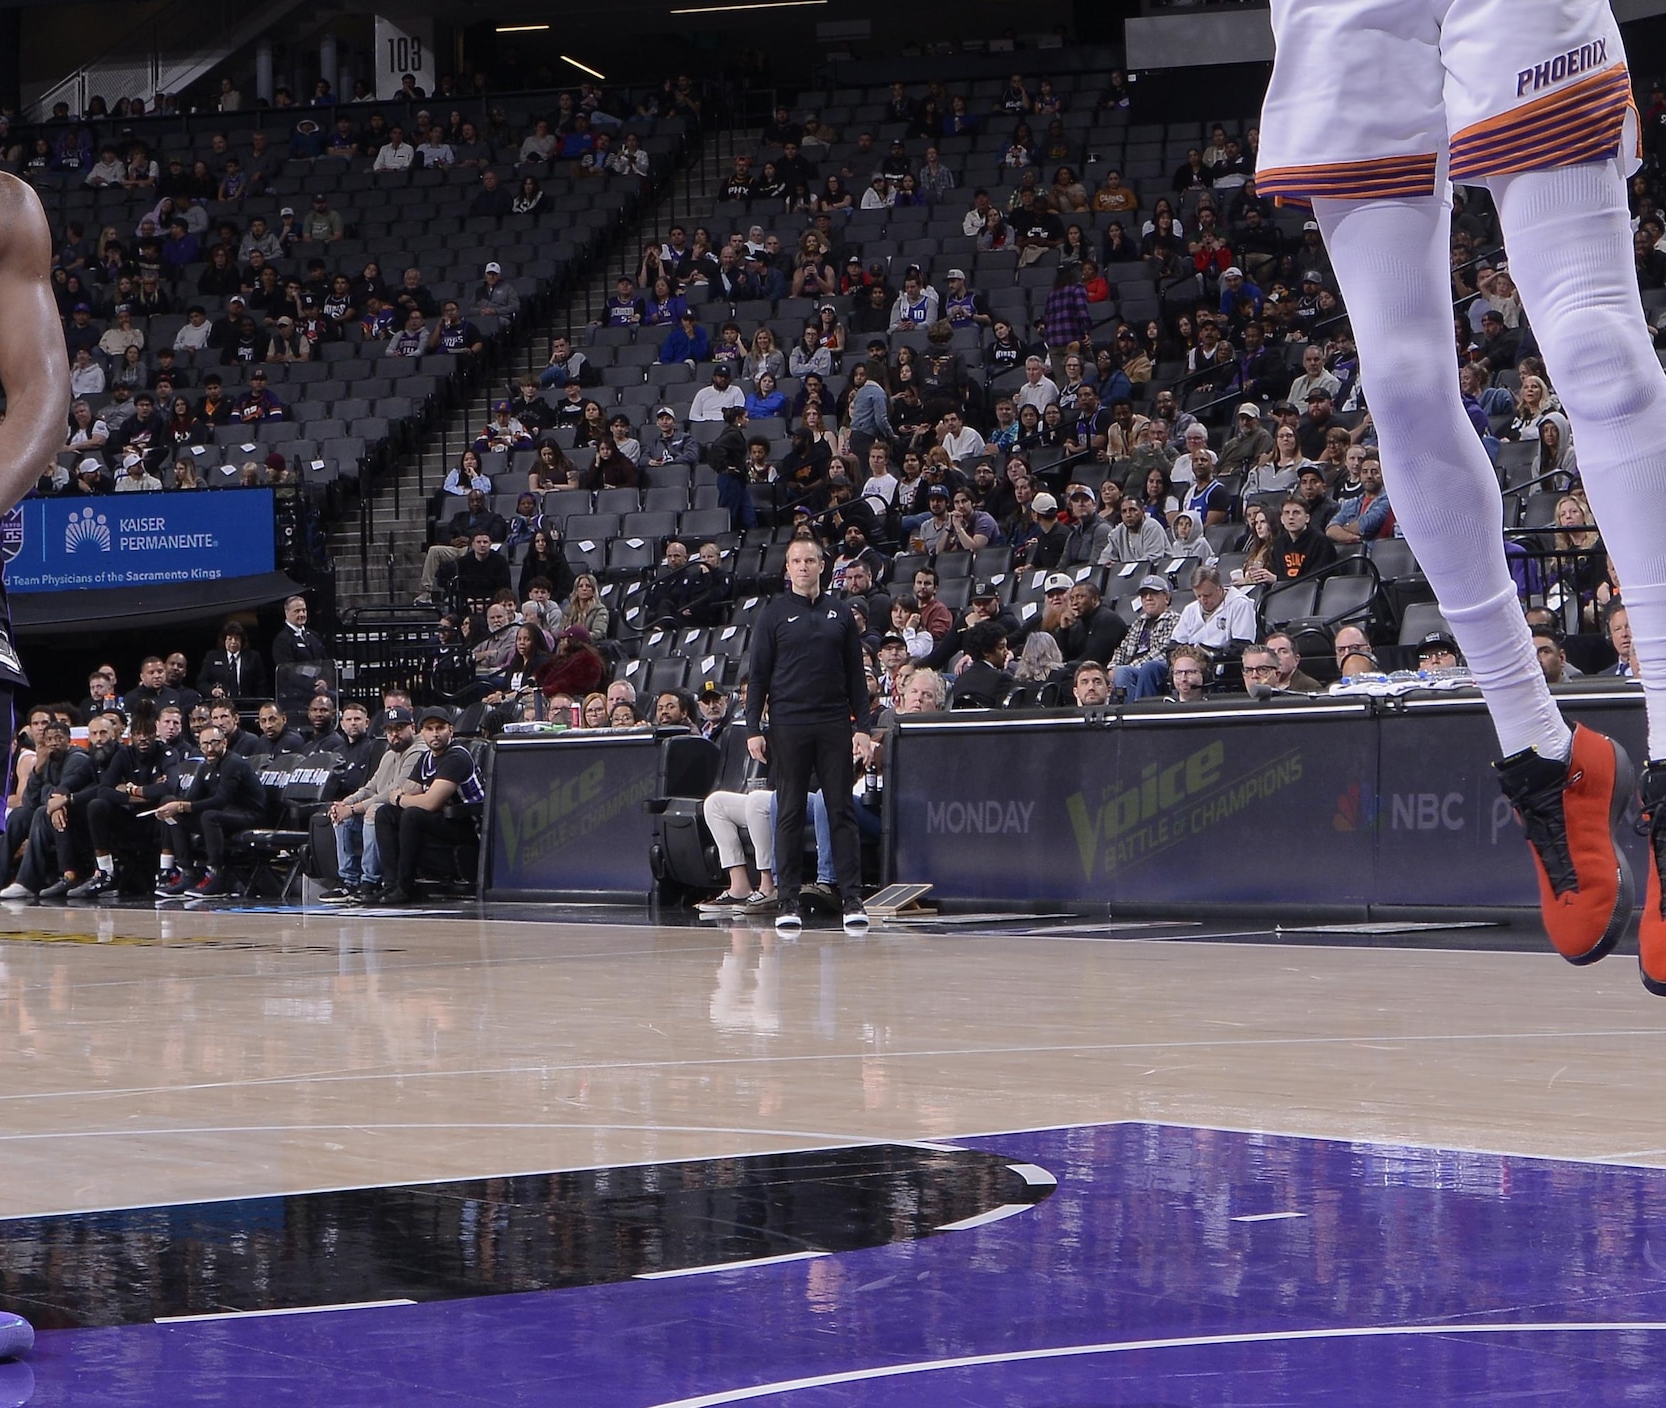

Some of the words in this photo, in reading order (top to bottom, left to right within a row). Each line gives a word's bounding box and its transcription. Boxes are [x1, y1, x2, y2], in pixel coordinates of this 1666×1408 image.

[388, 36, 422, 73] 103
[1516, 37, 1609, 98] PHOENIX
[728, 186, 750, 196] PHX
[912, 309, 925, 320] 10
[120, 517, 165, 532] KAISER
[120, 534, 213, 551] PERMANENTE
[13, 575, 40, 586] Team
[42, 572, 93, 587] Physicians
[95, 572, 105, 583] of
[107, 571, 124, 582] the
[126, 570, 188, 582] Sacramento
[191, 568, 222, 581] Kings
[498, 759, 606, 876] Voice
[926, 800, 1035, 835] MONDAY
[1066, 739, 1224, 883] Voice
[1104, 820, 1169, 872] BATTLE
[1191, 754, 1303, 834] CHAMPIONS
[1391, 792, 1465, 830] NBC
